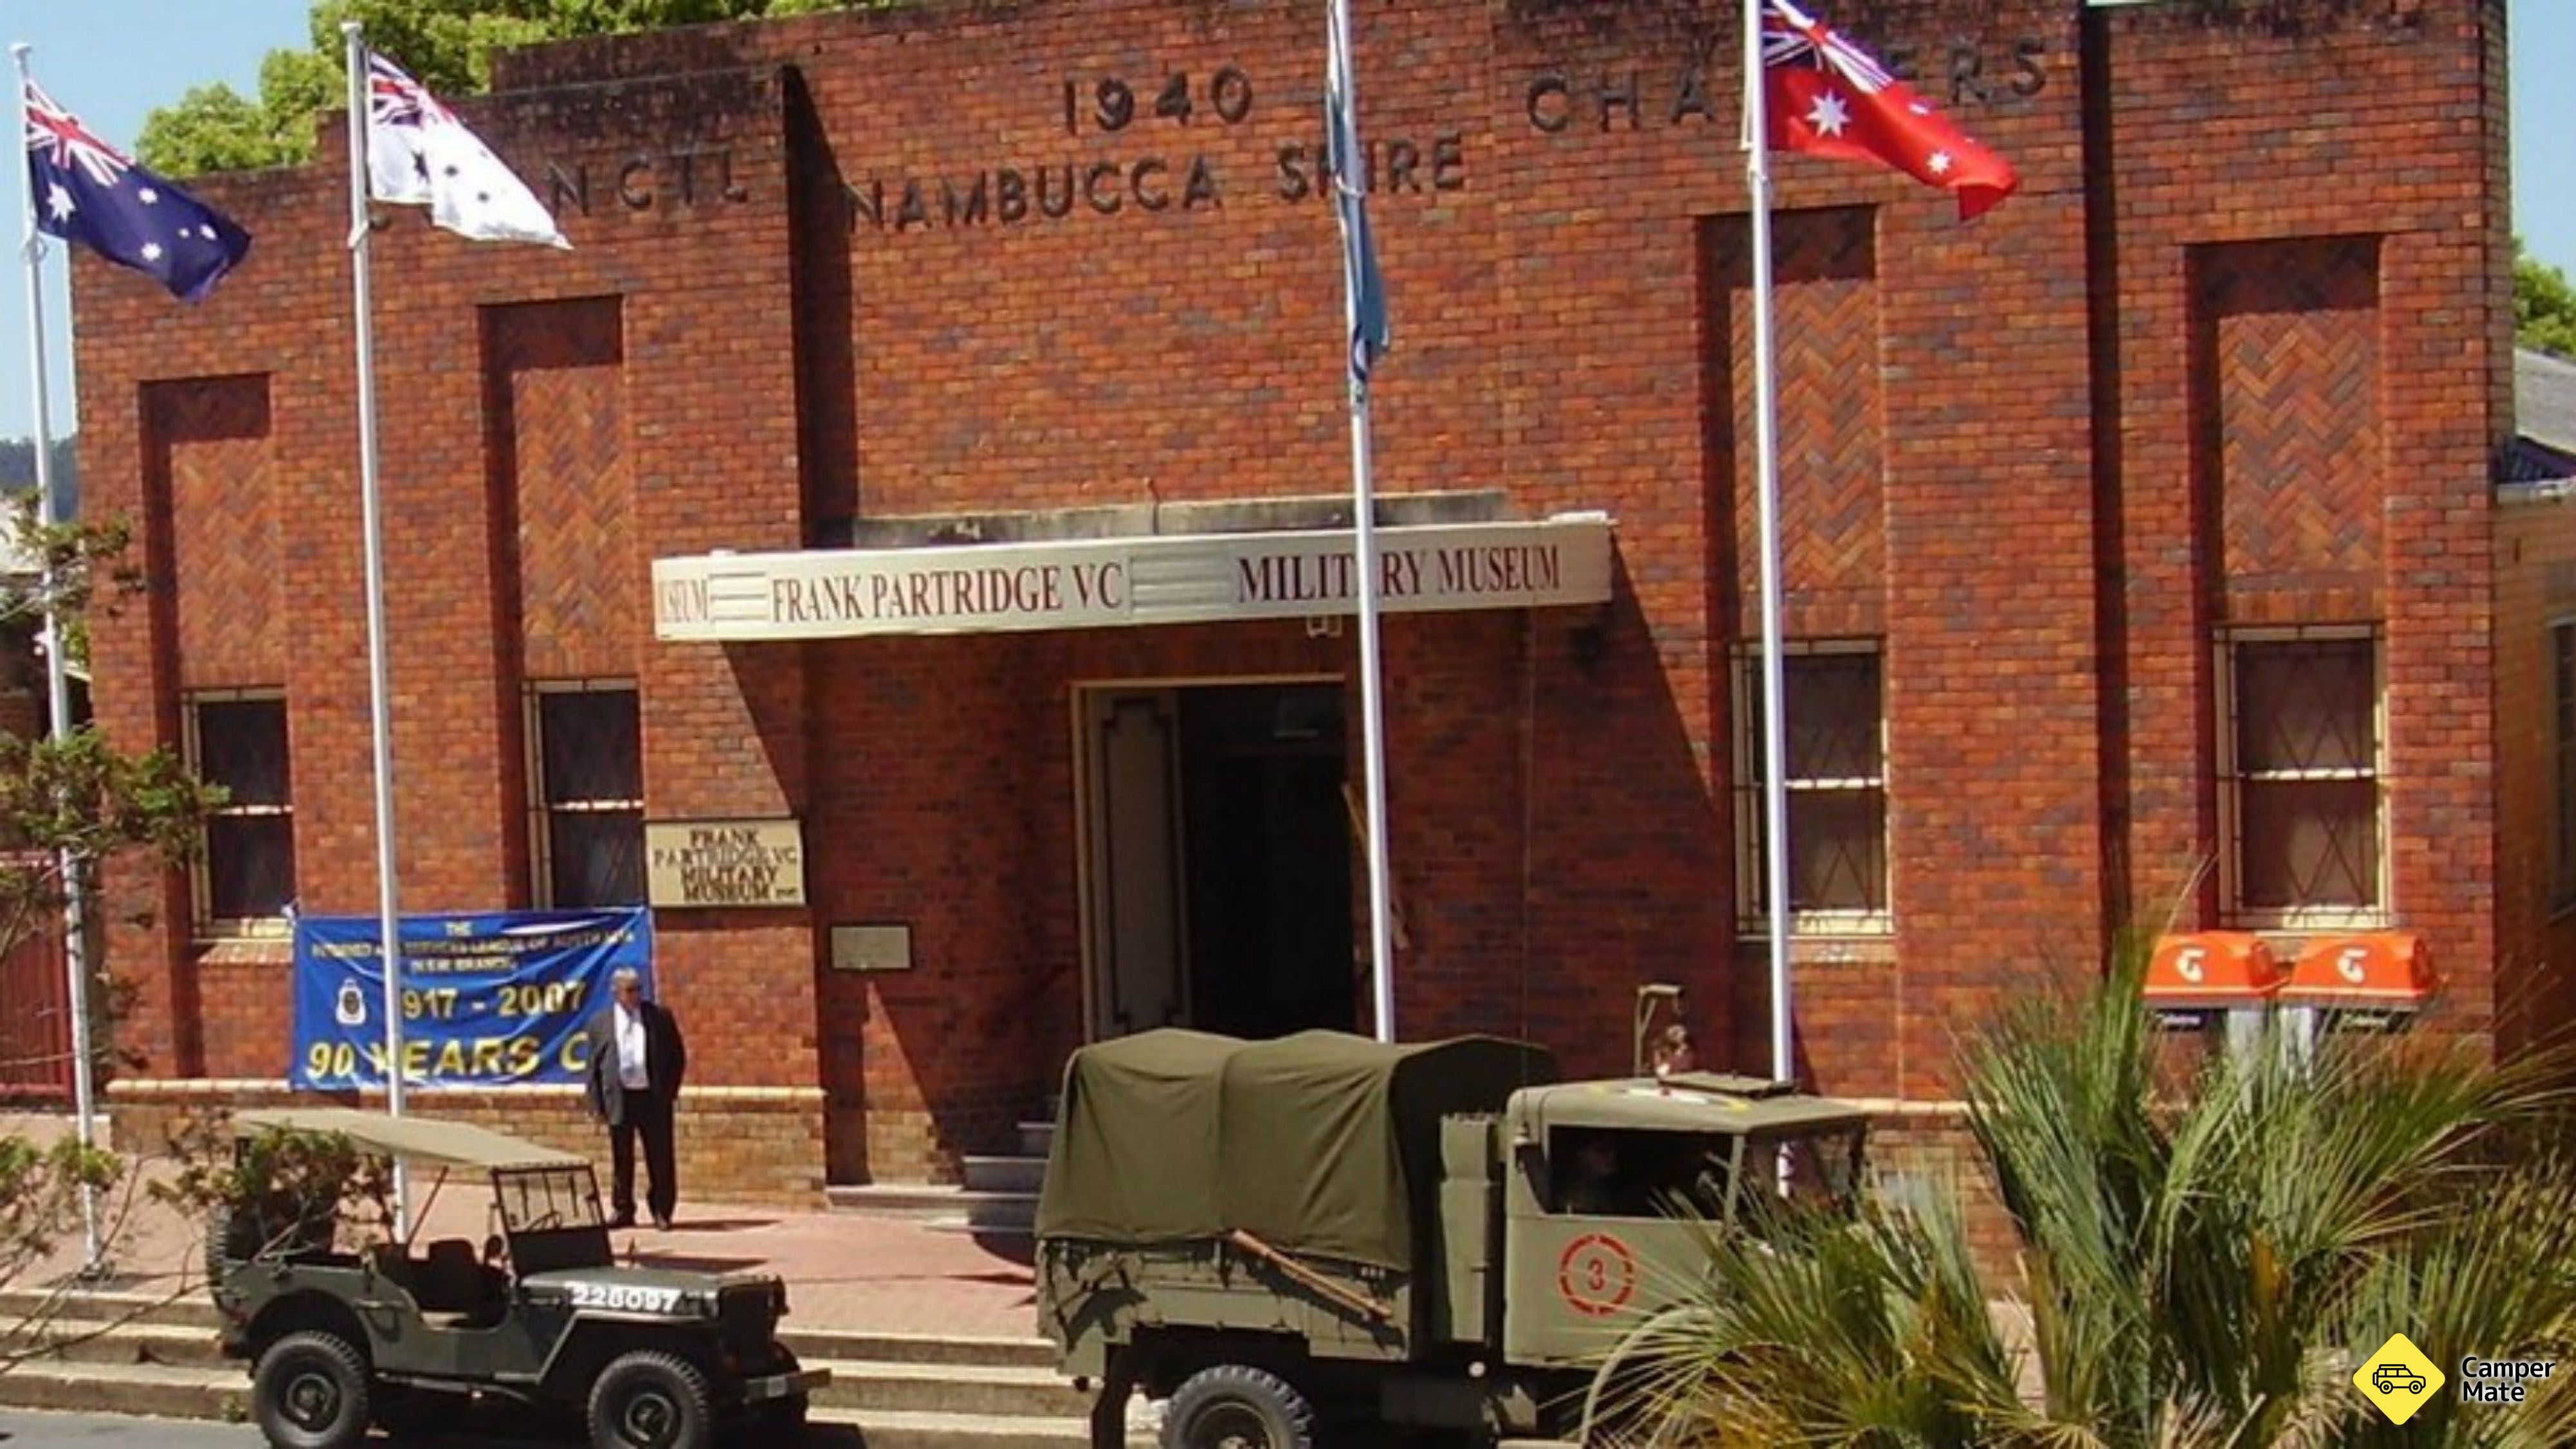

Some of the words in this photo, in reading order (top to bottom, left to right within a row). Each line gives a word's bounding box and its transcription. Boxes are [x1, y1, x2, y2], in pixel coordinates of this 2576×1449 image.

[1063, 66, 1253, 135] 1940
[845, 155, 1221, 232] NAMBUCCA
[773, 574, 862, 623] FRANK
[872, 565, 1063, 620] PARTRIDGE
[1072, 561, 1123, 609] VC
[1238, 549, 1428, 603] MILITRY
[1437, 544, 1561, 595] MUSEUM
[402, 987, 458, 1019] 917
[498, 980, 586, 1017] 2007
[309, 1041, 355, 1077] 90
[1587, 1258, 1604, 1291] 3
